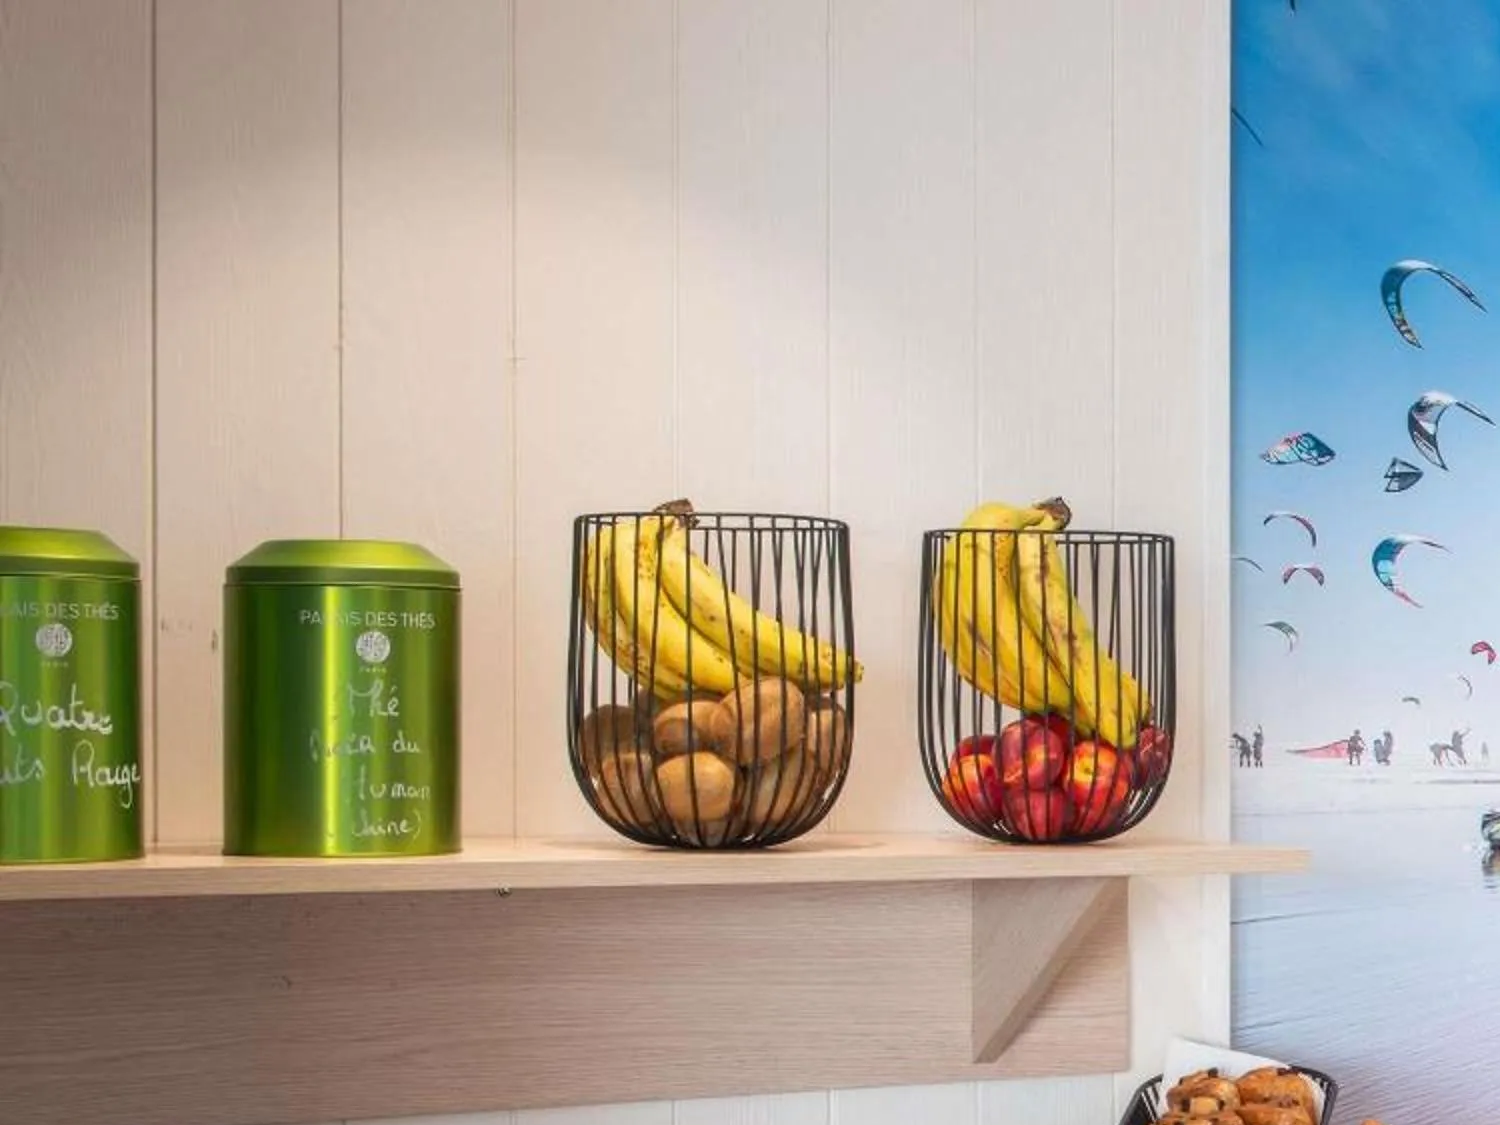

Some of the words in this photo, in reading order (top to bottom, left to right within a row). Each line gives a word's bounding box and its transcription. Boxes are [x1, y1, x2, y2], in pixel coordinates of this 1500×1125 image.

[45, 602, 80, 619] DES
[365, 611, 397, 627] DES
[347, 678, 400, 717] Thé
[392, 730, 421, 753] du
